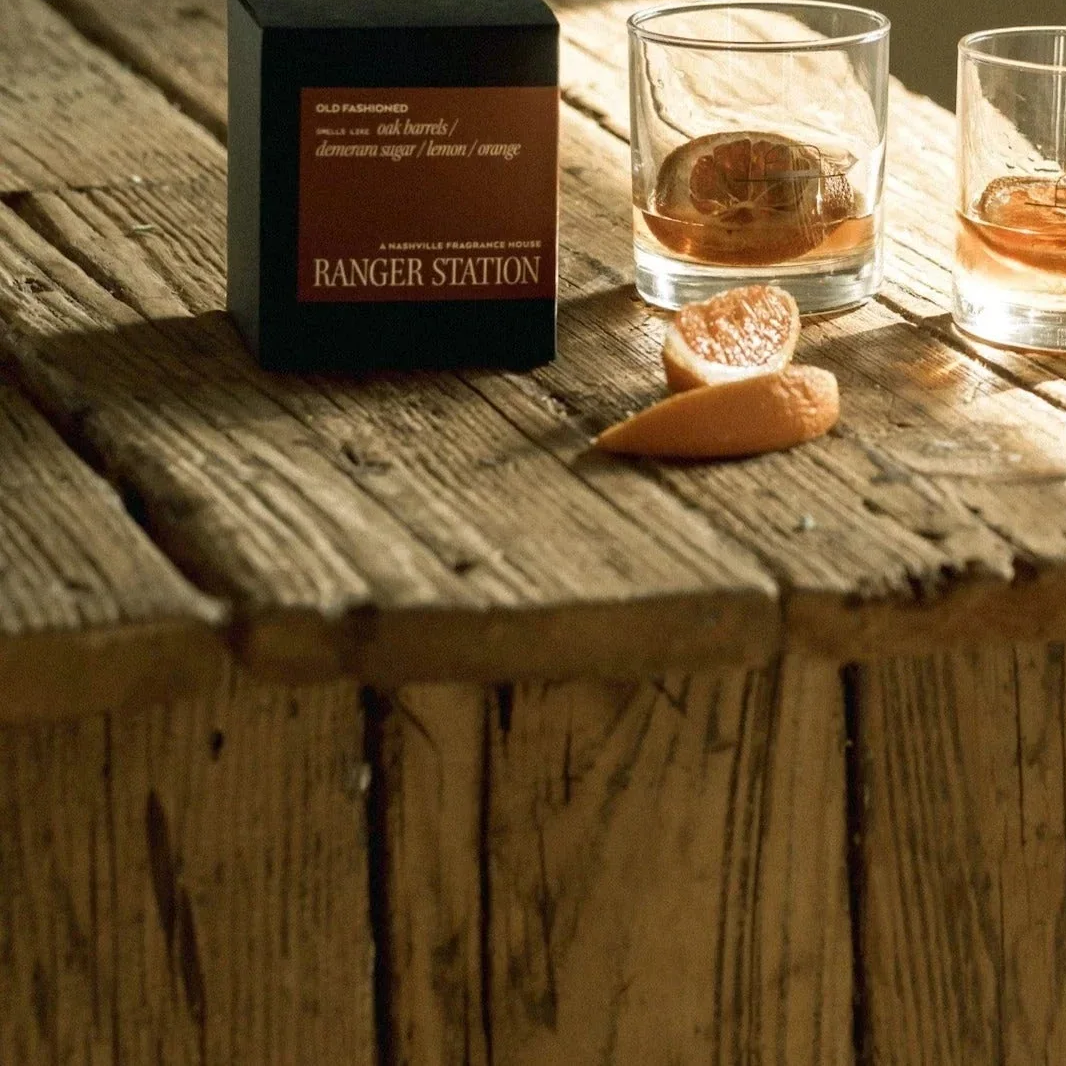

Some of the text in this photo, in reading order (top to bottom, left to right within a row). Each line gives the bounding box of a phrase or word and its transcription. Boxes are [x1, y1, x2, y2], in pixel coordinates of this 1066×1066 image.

[316, 103, 408, 113] OLD FASHIONED
[377, 118, 402, 135] oak
[403, 118, 449, 135] barrels
[315, 139, 378, 157] demerara
[380, 144, 417, 162] sugar
[427, 139, 467, 157] lemon
[477, 143, 522, 161] orange
[388, 242, 444, 250] NASHVILLE
[446, 241, 505, 249] FRAGRANCE
[508, 240, 542, 248] HOUSE
[313, 255, 542, 287] RANGER STATION
